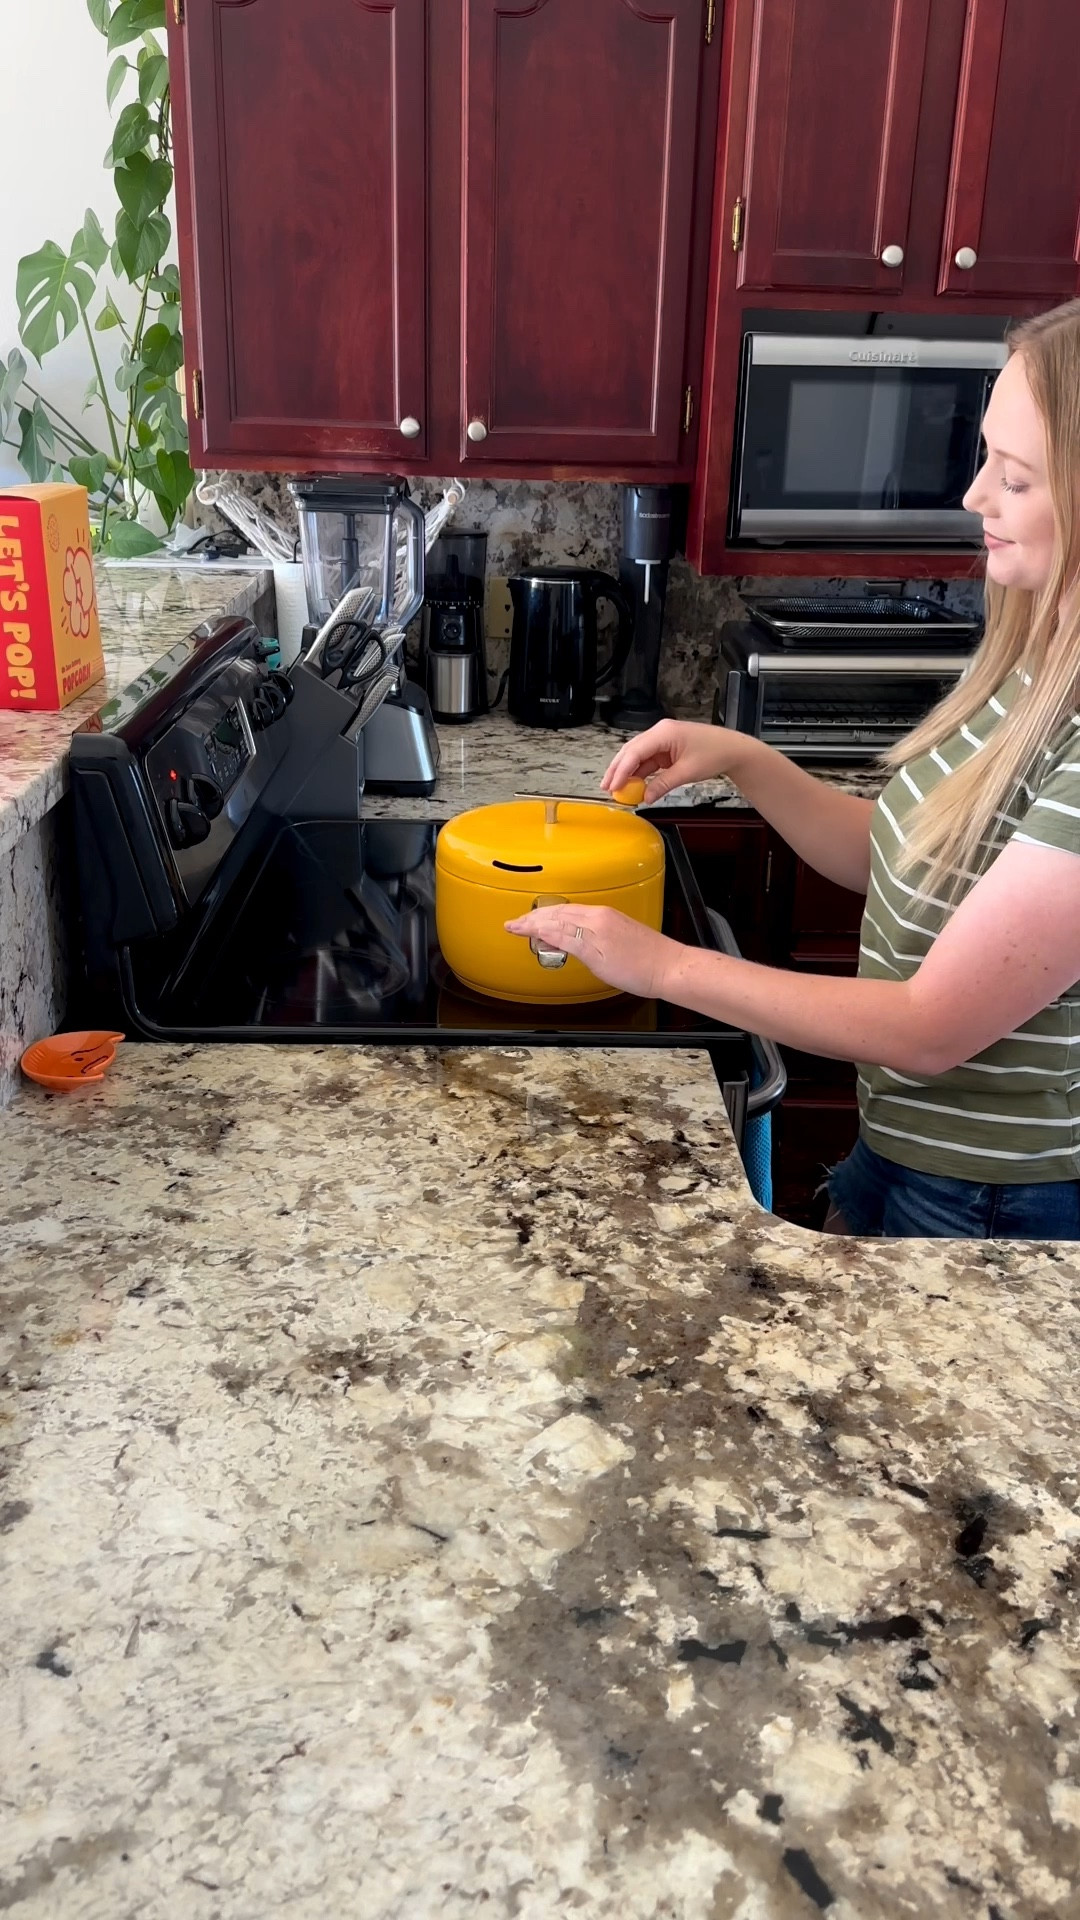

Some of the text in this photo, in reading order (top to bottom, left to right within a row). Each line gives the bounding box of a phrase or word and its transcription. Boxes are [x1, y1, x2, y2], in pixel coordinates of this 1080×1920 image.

[849, 351, 917, 363] Cuisinart
[0, 515, 37, 699] LET'S POP!
[62, 661, 91, 696] POPCORN
